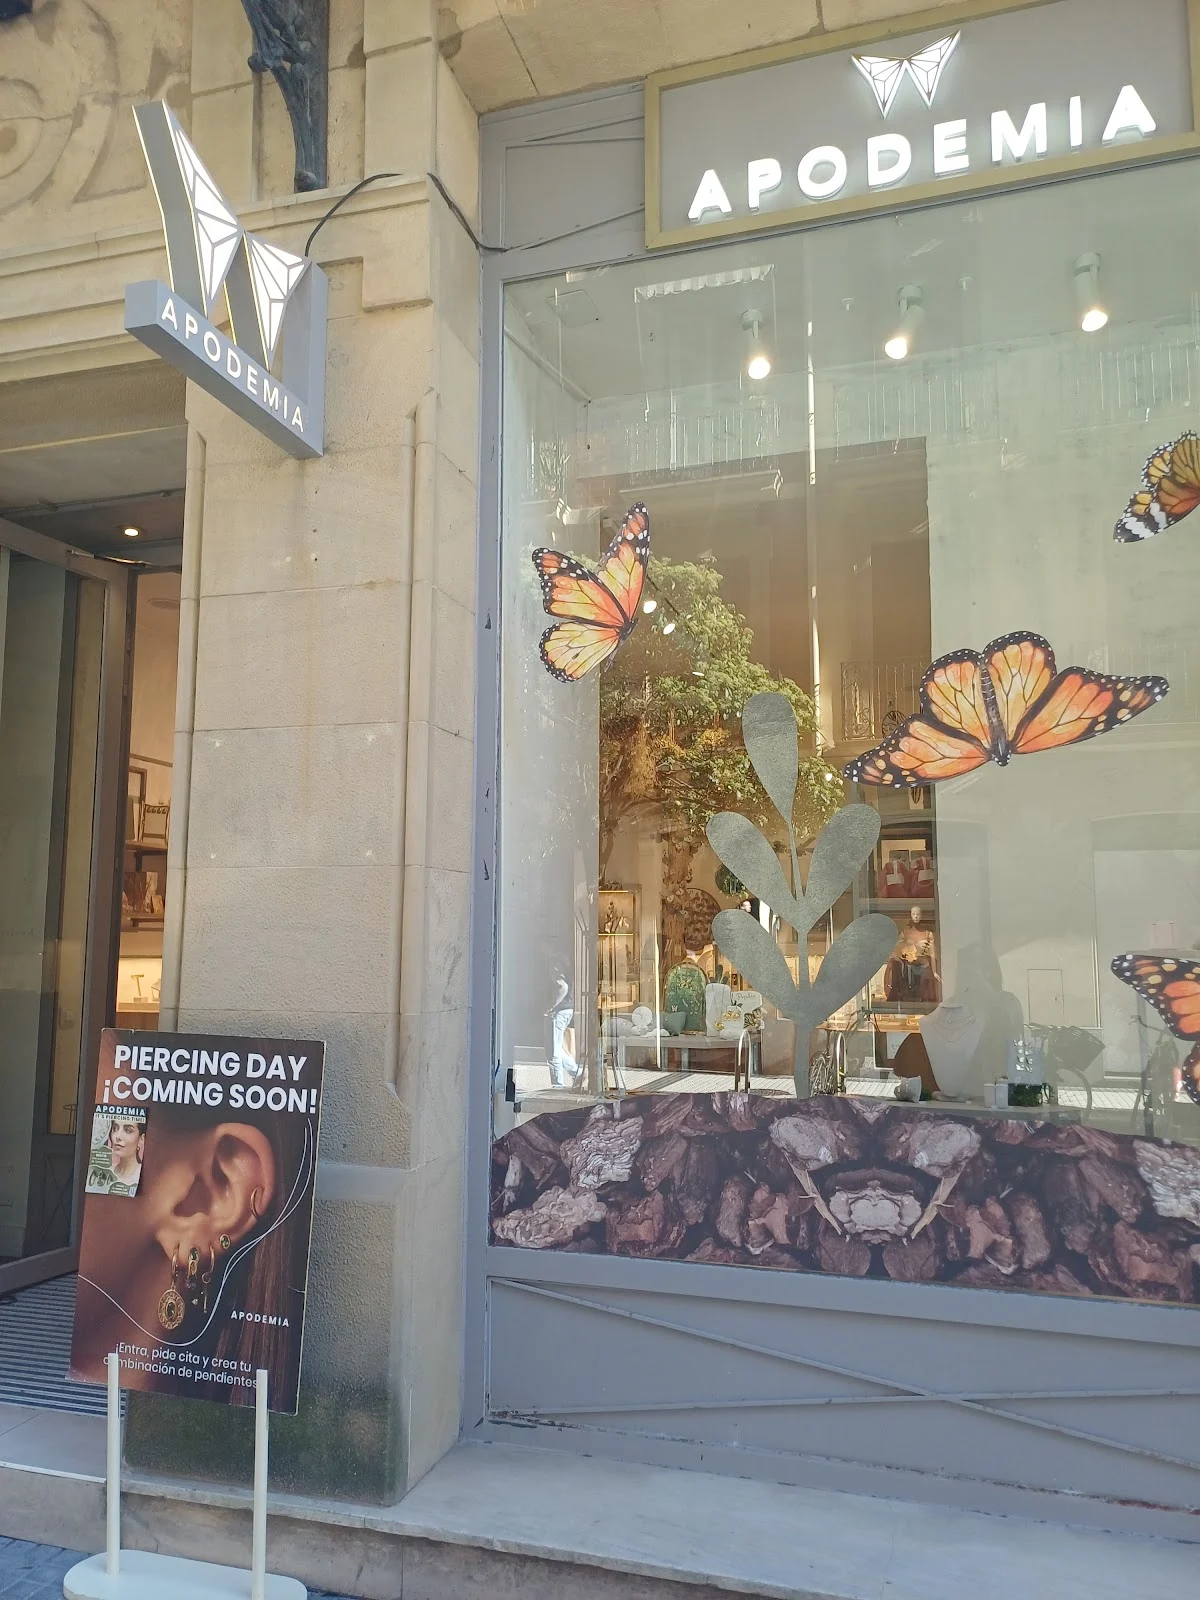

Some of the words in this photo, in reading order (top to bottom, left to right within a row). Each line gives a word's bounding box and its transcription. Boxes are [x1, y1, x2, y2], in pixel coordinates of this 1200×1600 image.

[688, 84, 1157, 222] APODEMIA
[161, 298, 304, 433] APODEMIA
[114, 1045, 241, 1077] PIERCING
[246, 1053, 308, 1081] DAY
[95, 1104, 146, 1117] APODEMIA
[102, 1076, 223, 1107] ¡COMING
[228, 1084, 318, 1114] SOON!
[230, 1310, 290, 1328] APODEMIA
[103, 1356, 175, 1376] cmbinación
[177, 1366, 192, 1378] de
[151, 1347, 176, 1361] pide
[178, 1351, 200, 1365] cita
[202, 1356, 209, 1369] y
[211, 1358, 237, 1371] crea
[239, 1360, 251, 1373] tu
